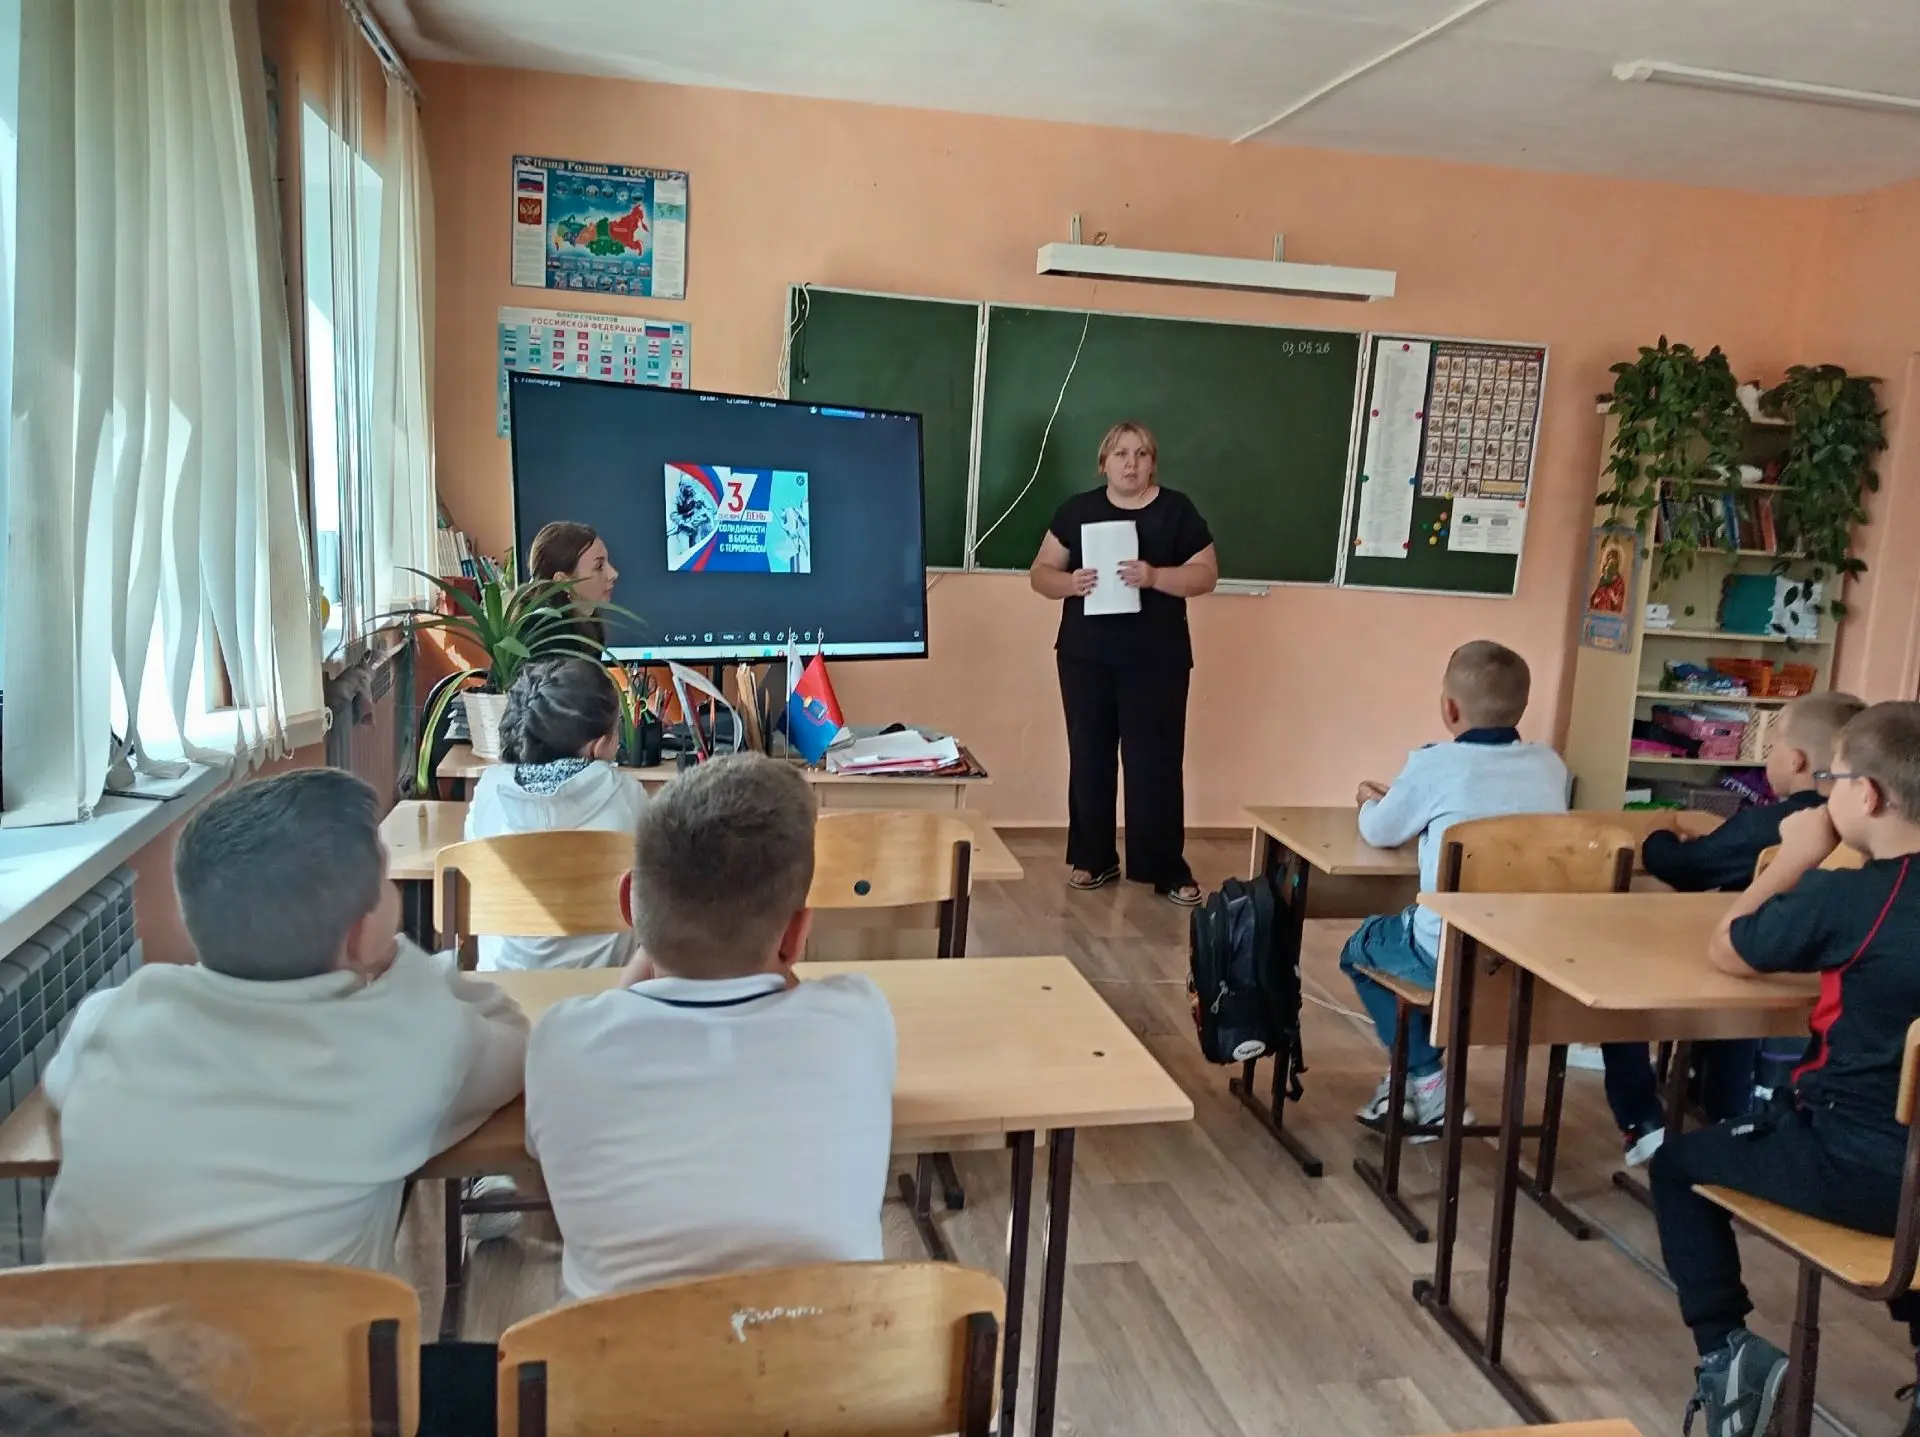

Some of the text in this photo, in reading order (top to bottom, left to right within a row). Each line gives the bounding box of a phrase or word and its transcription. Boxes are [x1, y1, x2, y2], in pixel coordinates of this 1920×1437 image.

[534, 158, 565, 170] Наша
[568, 161, 608, 174] Родина
[623, 166, 668, 180] РОССИЯ
[531, 317, 643, 333] РОССИЙСКОЙ ФЕДЕРАЦИИ
[727, 482, 744, 512] 3
[746, 511, 767, 521] ДЕНЬ
[719, 523, 766, 534] СОЛИДАРНОСТИ
[728, 533, 758, 544] В БОРЬБЕ
